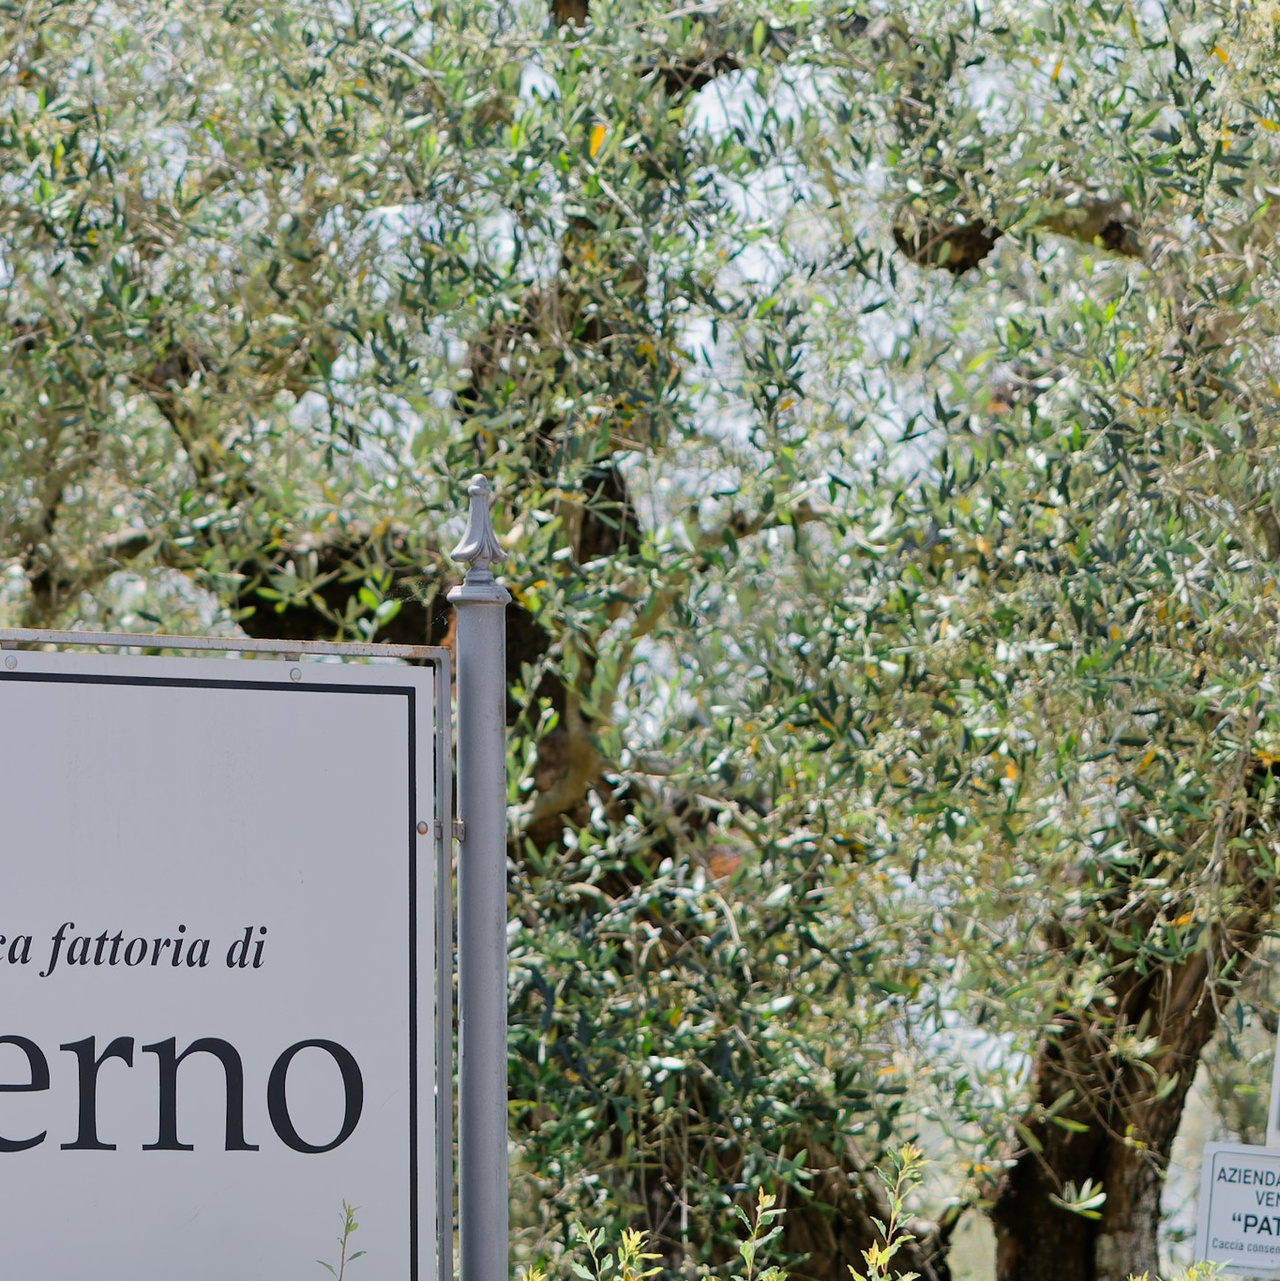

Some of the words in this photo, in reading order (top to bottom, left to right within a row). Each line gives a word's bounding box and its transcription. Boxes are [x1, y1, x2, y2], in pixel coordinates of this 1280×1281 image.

[38, 922, 212, 978] fattoria
[225, 925, 268, 969] di
[1211, 1237, 1244, 1251] Caccia
